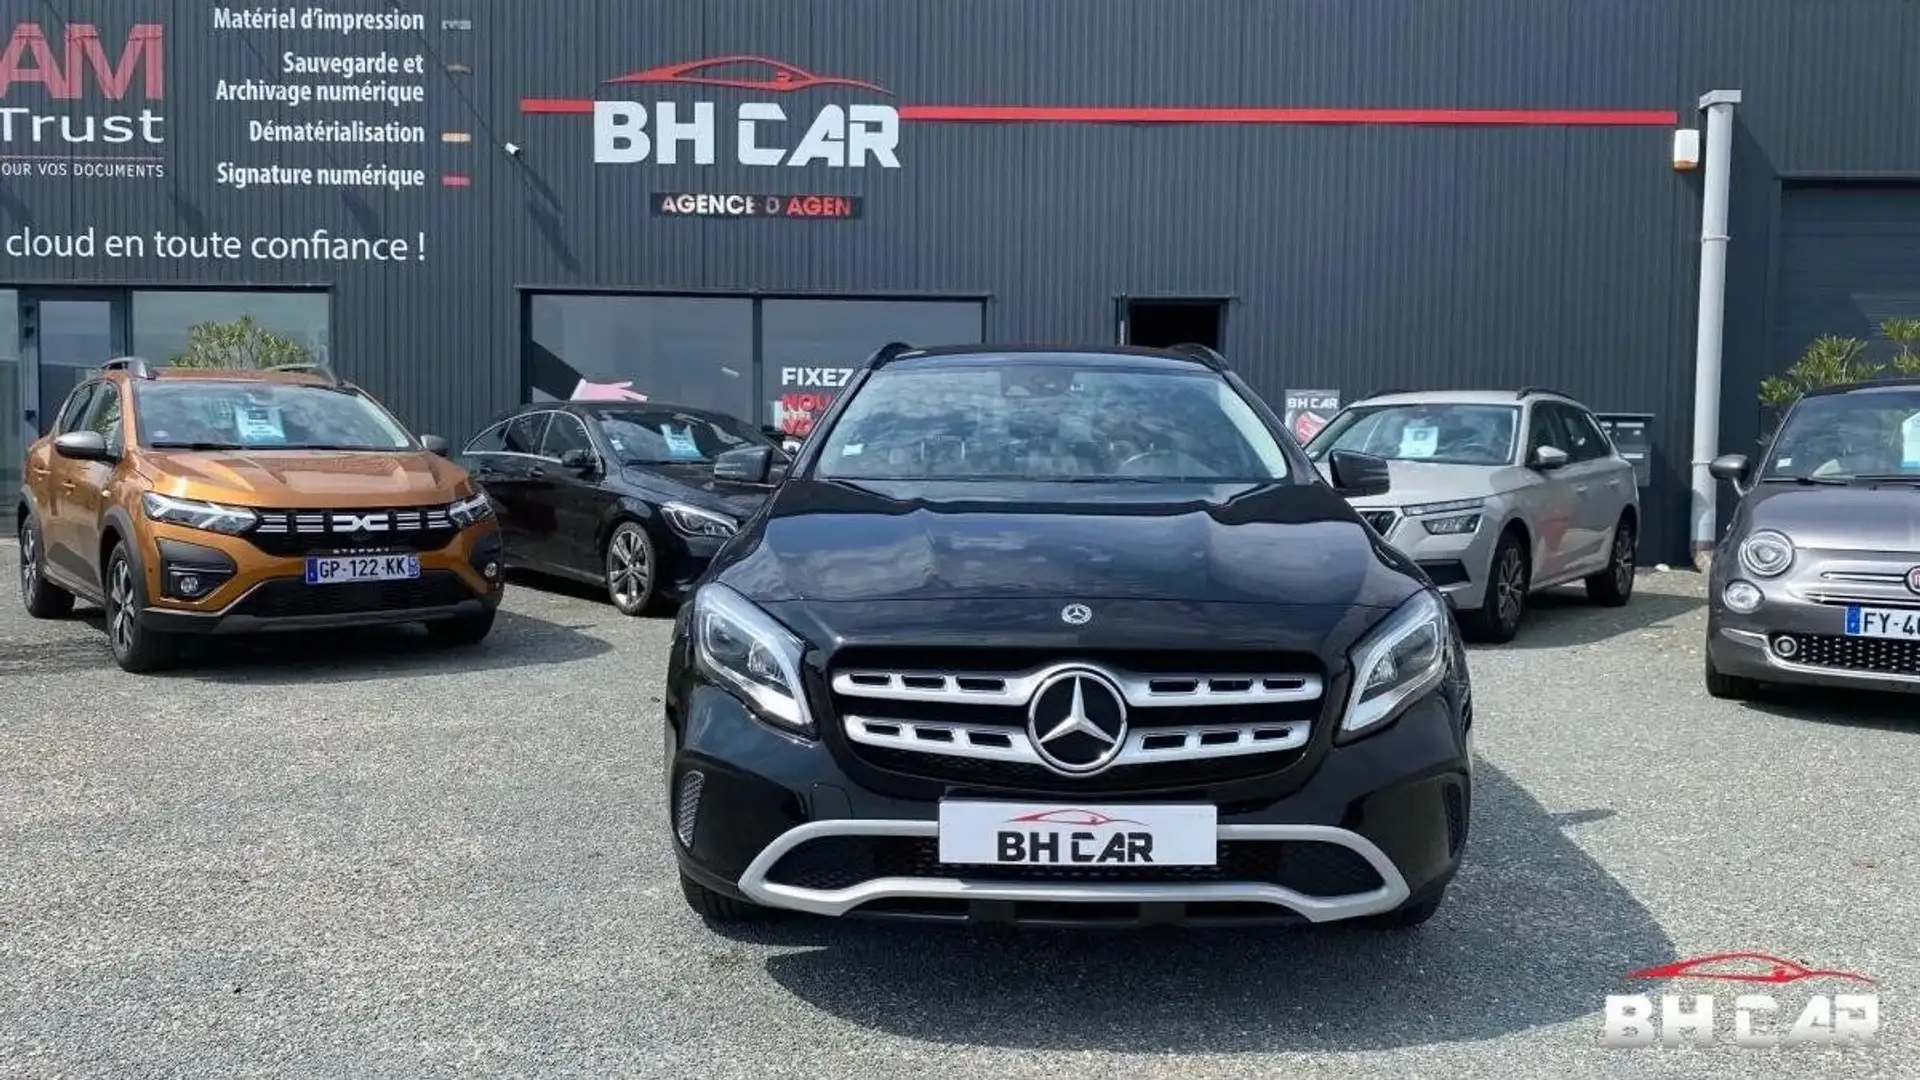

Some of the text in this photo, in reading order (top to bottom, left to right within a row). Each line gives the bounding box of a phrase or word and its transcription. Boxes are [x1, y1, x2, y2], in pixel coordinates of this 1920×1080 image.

[214, 8, 425, 35] Matériel d'impression
[283, 51, 424, 78] Sauvegarde et
[215, 79, 424, 110] Archivage numérique
[0, 107, 165, 144] Trust
[249, 119, 425, 144] Dématérialisation
[593, 100, 901, 168] BH CAR
[38, 162, 68, 177] VOS
[73, 163, 165, 179] DOCUMENTS
[217, 161, 425, 191] Signature numérique
[661, 194, 756, 215] AGENCE
[785, 197, 851, 217] AGEN
[6, 226, 426, 261] cloud en toute confiance !
[1288, 398, 1338, 410] BH CAR
[319, 557, 406, 579] GP-122-KK
[997, 831, 1154, 863] BH CAR
